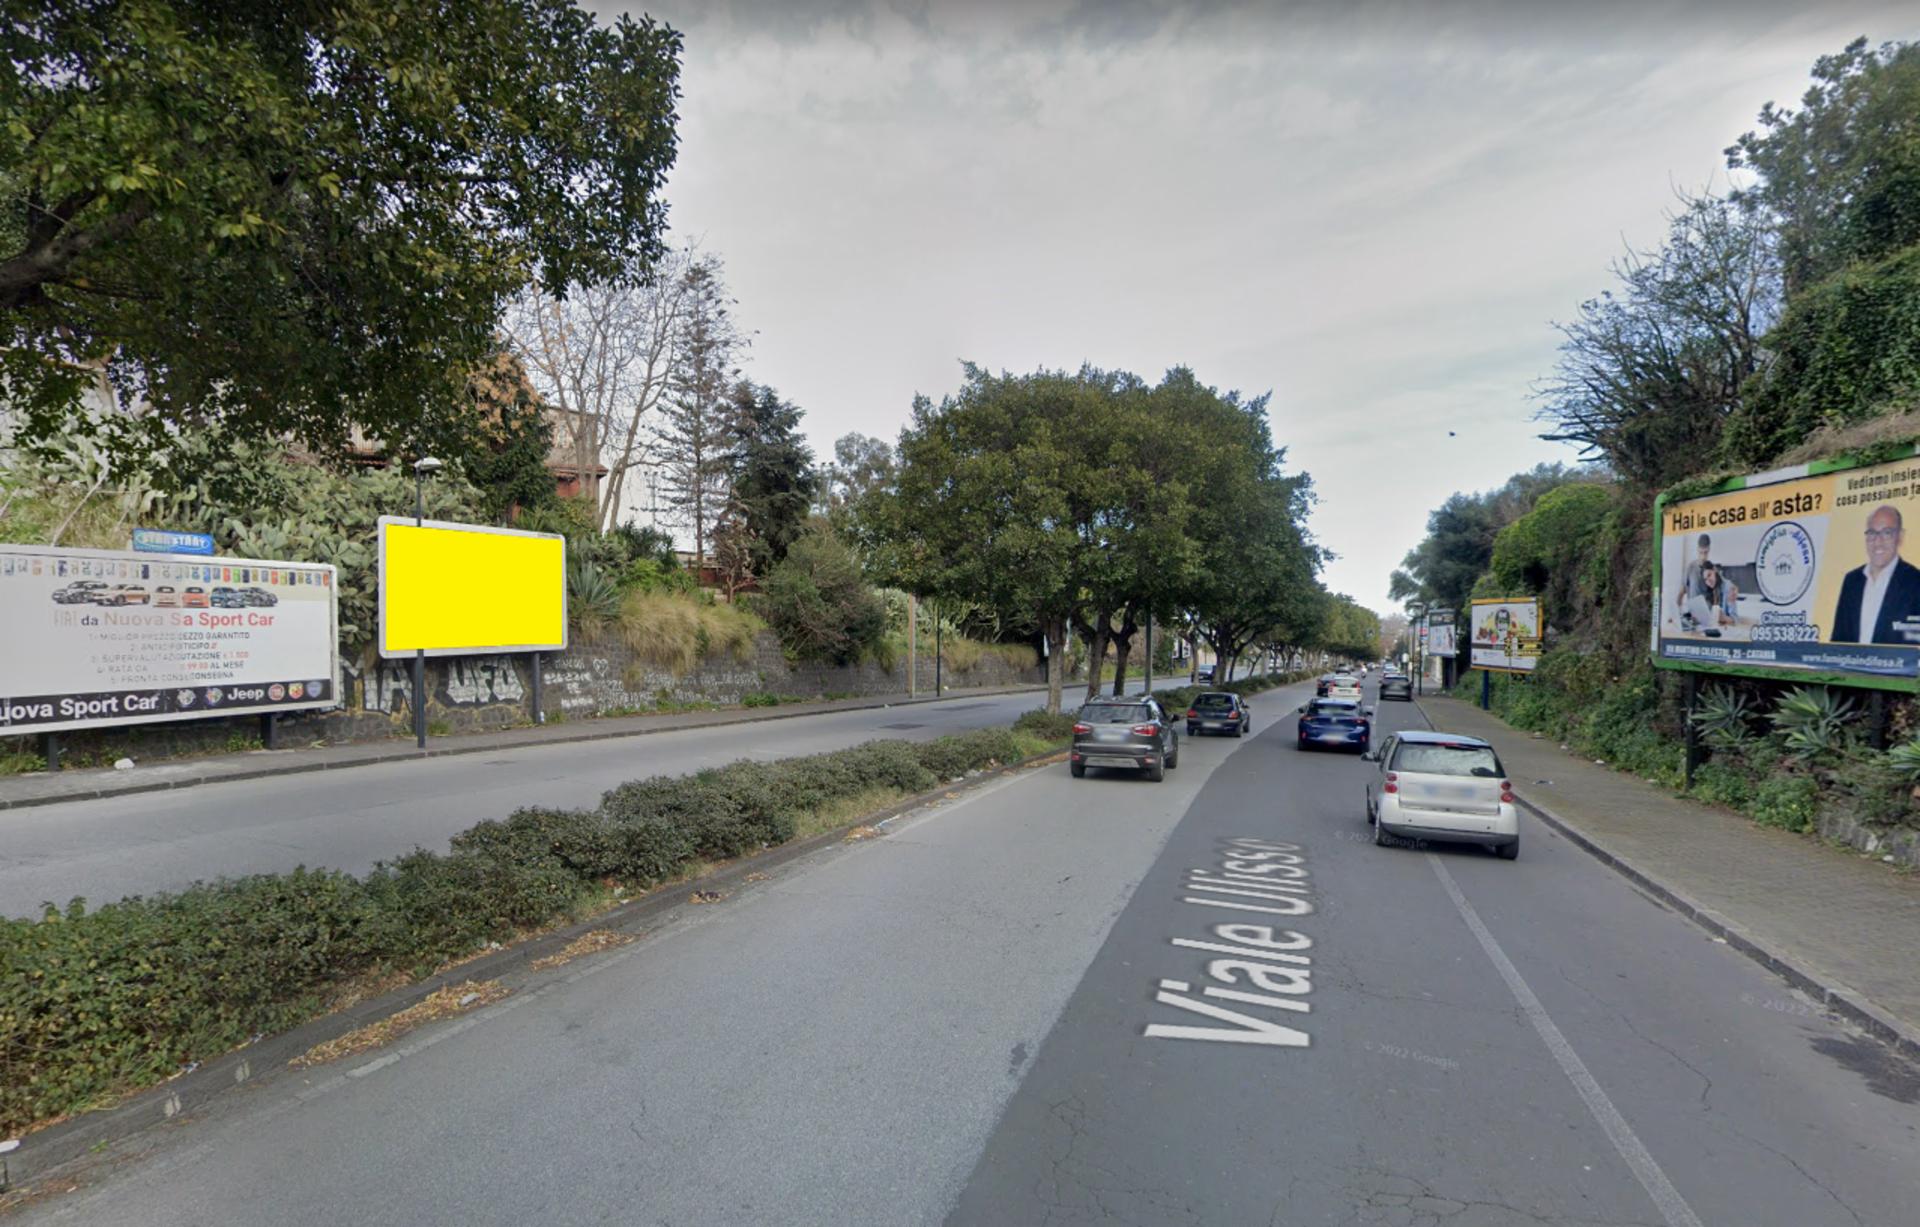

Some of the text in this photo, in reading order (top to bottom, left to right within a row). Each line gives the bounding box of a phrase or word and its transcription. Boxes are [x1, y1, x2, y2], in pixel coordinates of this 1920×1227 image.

[1891, 467, 1920, 483] insie
[1836, 495, 1858, 507] cosa
[1860, 486, 1909, 505] possiamo
[1672, 510, 1695, 531] Hai
[1697, 514, 1707, 527] la
[1709, 505, 1747, 526] casa
[1772, 492, 1823, 517] asta?
[81, 614, 98, 626] da
[104, 612, 163, 627] Nuova
[199, 612, 243, 629] Sport
[248, 613, 274, 626] Car
[60, 698, 118, 718] Sport
[124, 694, 159, 711] Car
[227, 688, 264, 700] Jeep
